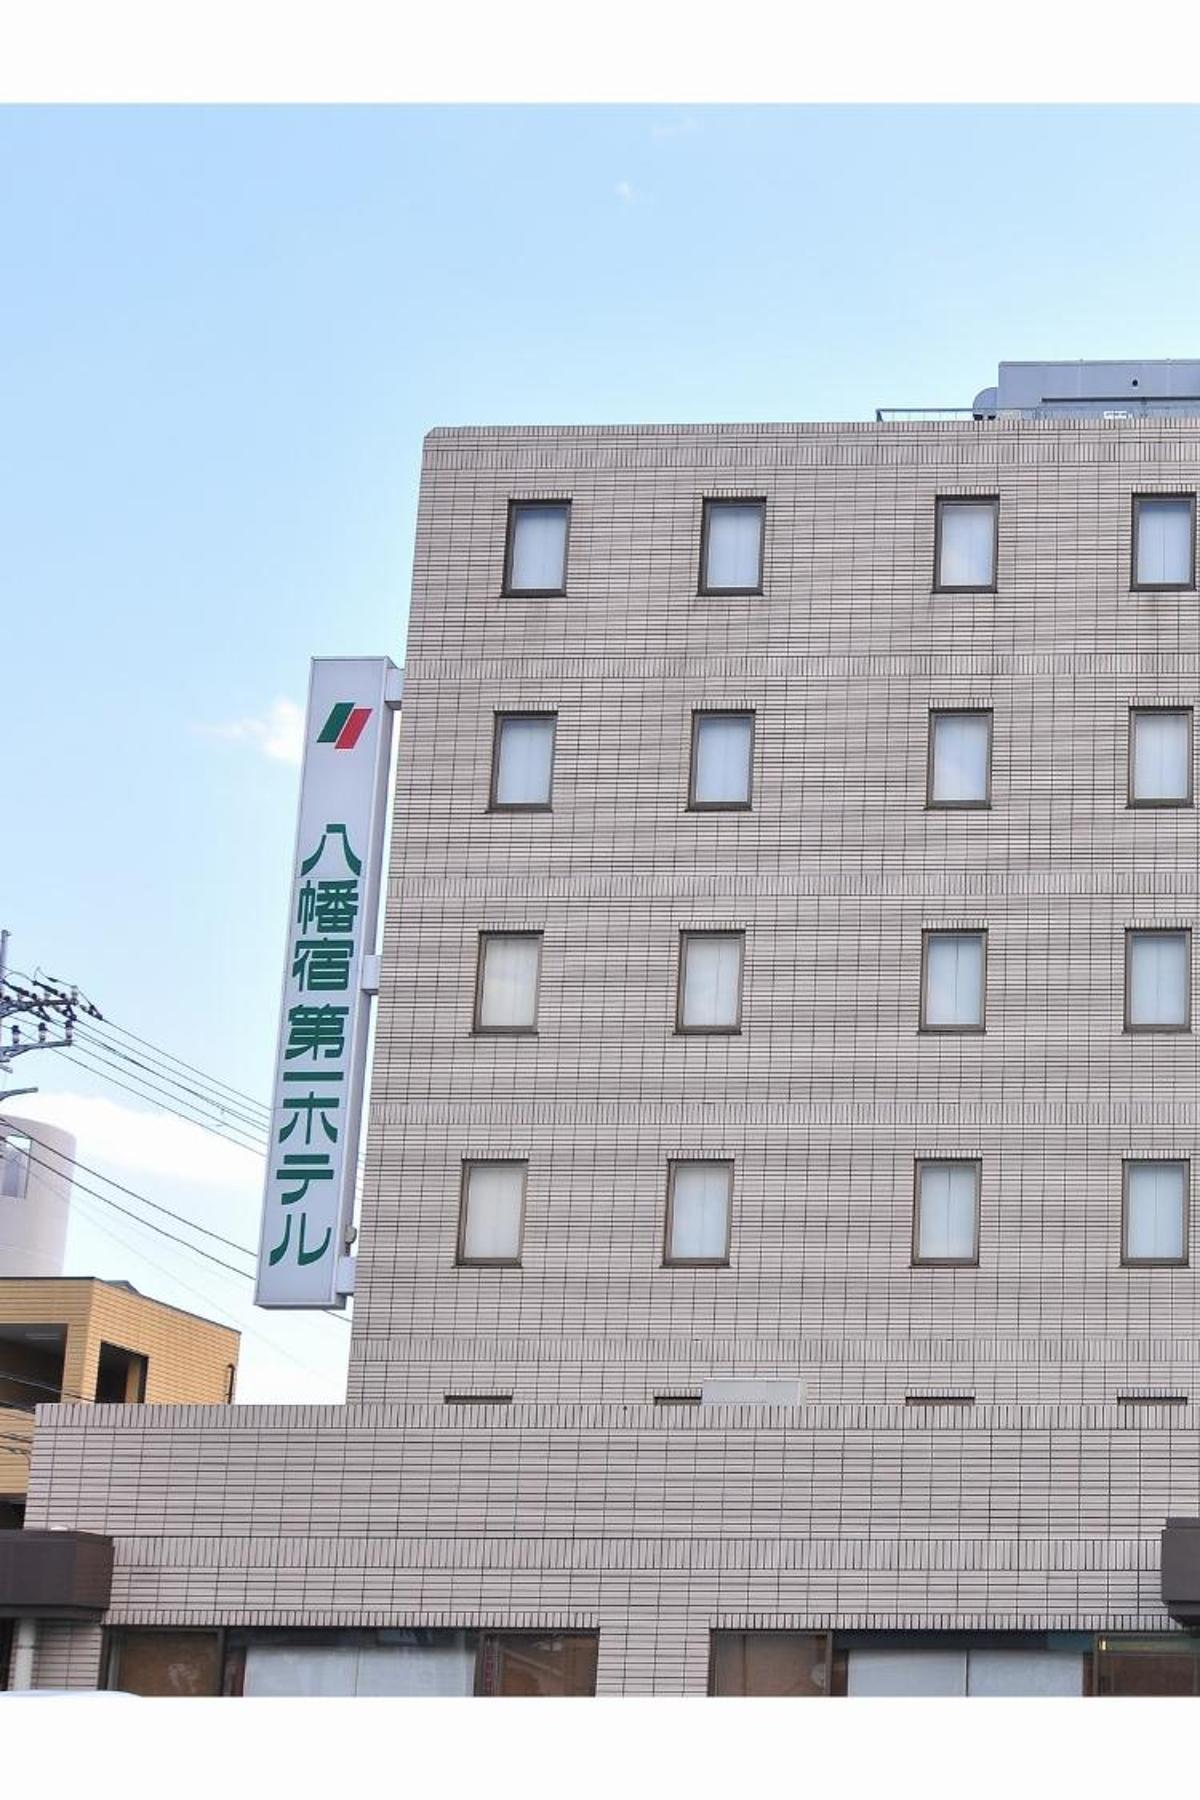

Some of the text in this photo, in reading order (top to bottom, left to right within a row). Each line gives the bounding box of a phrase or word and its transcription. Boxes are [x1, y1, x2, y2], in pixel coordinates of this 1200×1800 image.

[268, 824, 362, 1266] 八幡宿第一ホテル
